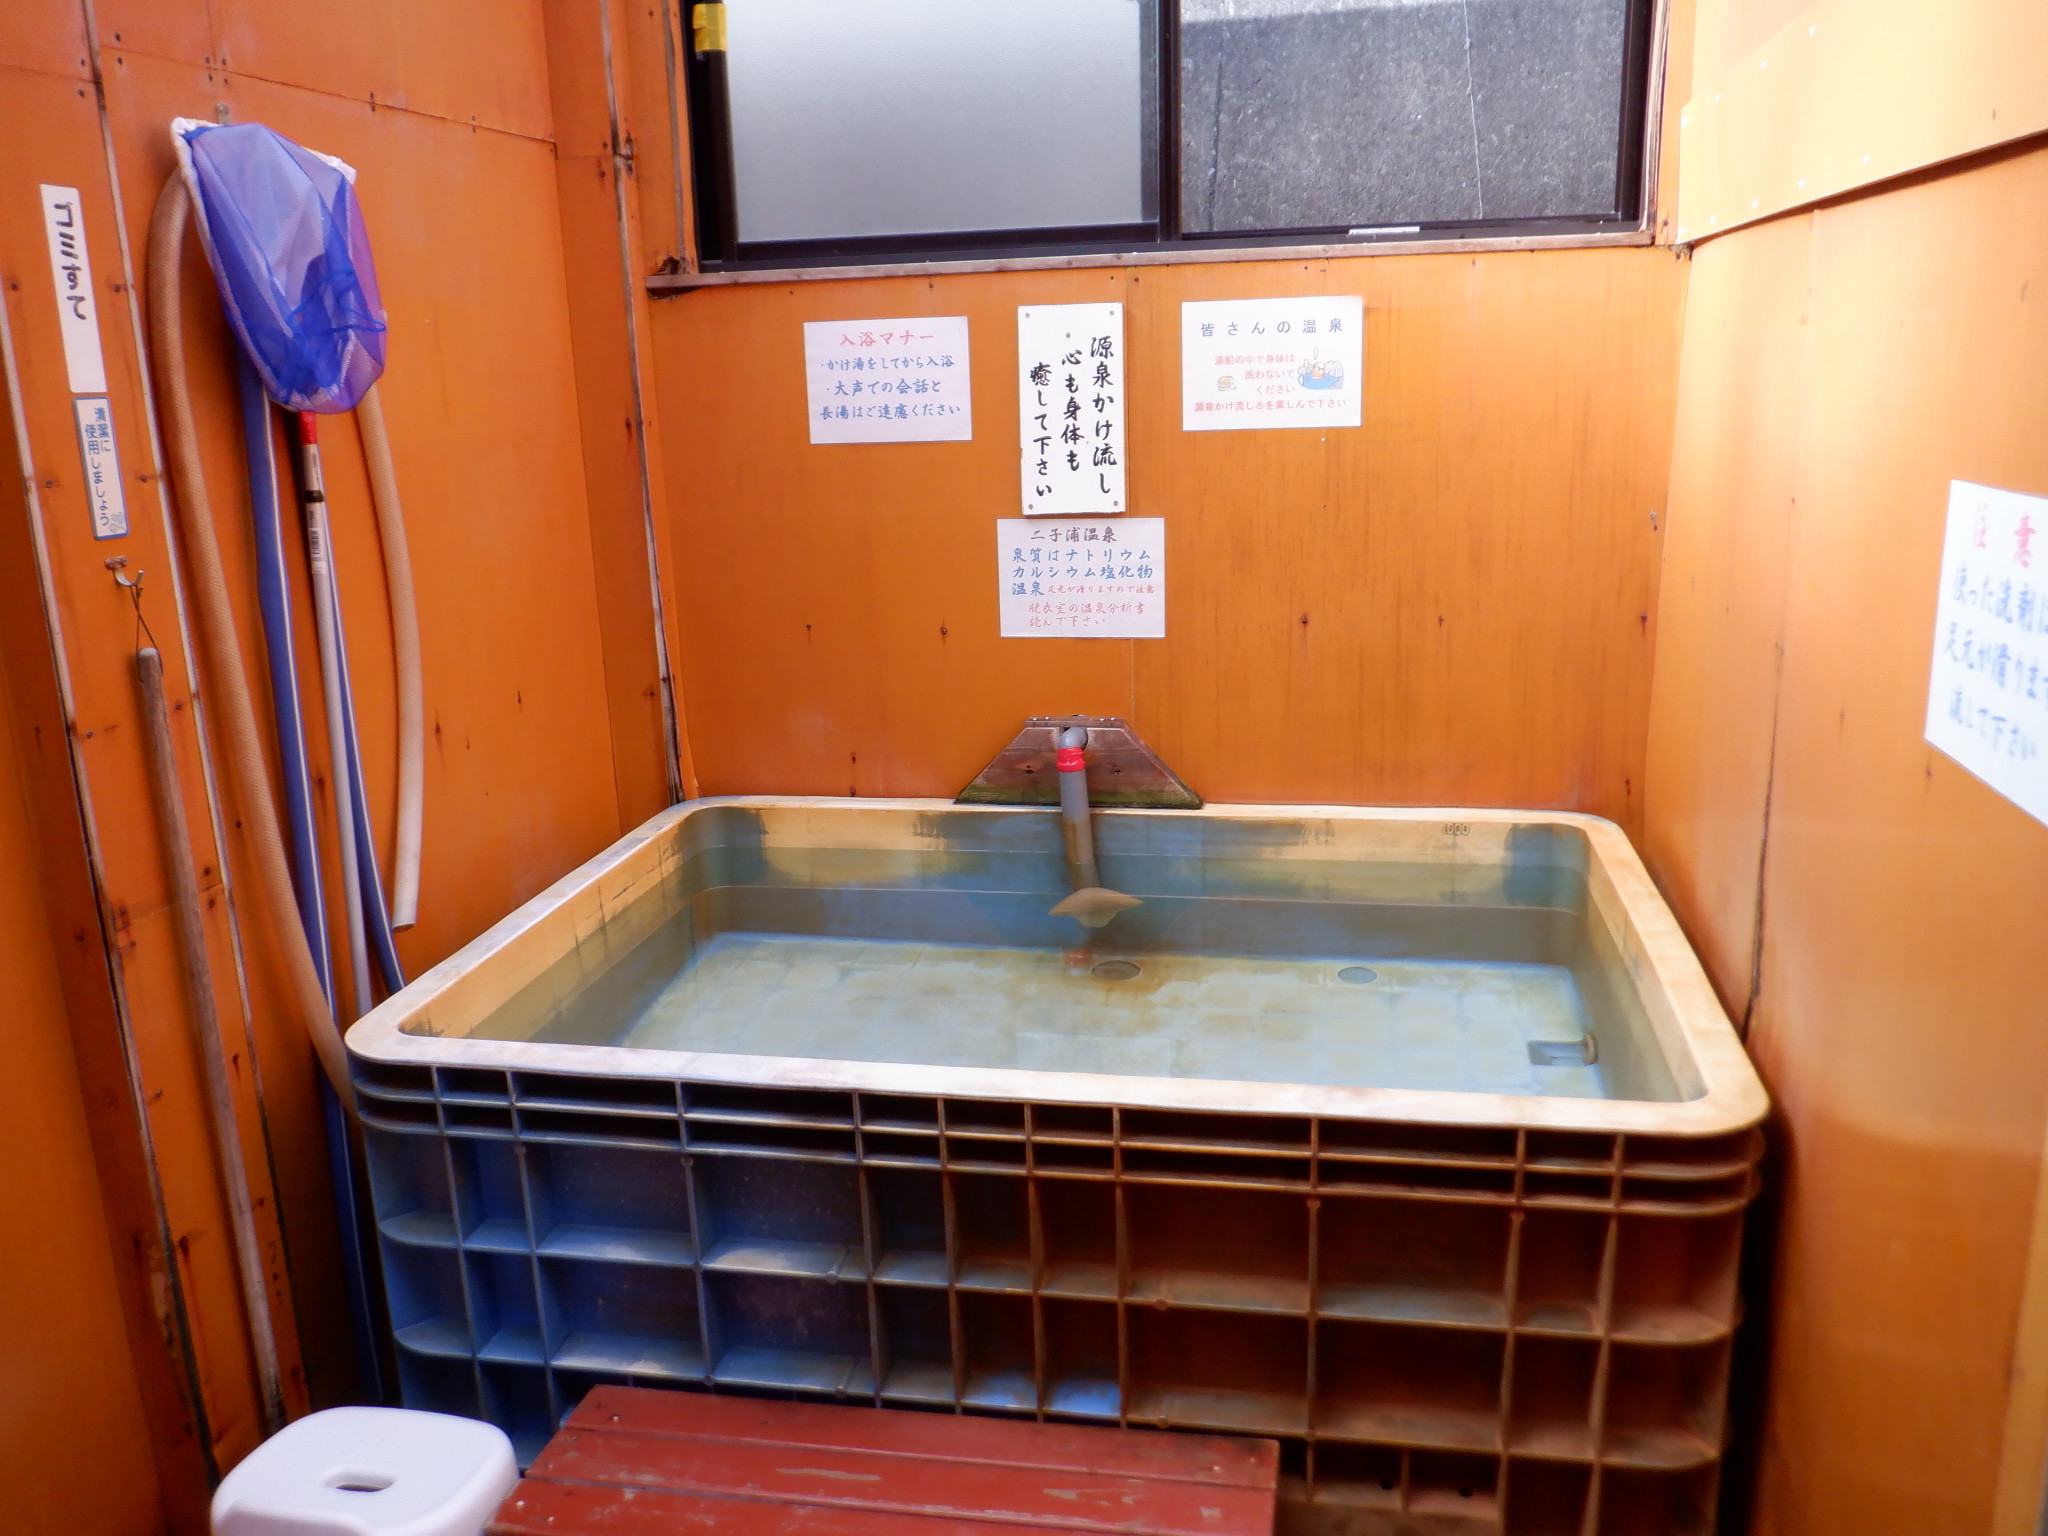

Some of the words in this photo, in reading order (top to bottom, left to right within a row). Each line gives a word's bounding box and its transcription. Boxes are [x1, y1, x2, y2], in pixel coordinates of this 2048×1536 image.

[53, 202, 87, 320] ゴミすて
[1200, 318, 1343, 337] 皆さんの温泉
[839, 330, 935, 347] 入浴マナー
[1214, 353, 1296, 366] 湯船の中で身体は
[1244, 369, 1296, 380] 洗わないで
[1255, 385, 1297, 395] ください
[819, 403, 961, 420] 長湯はご遠慮ください
[1060, 349, 1085, 472] 心も身体も
[1090, 335, 1117, 494] 源泉かけ流し
[93, 406, 112, 452] 清潔に
[1029, 361, 1052, 497] 癒して下さい
[84, 423, 110, 527] 使用しましょう
[1030, 526, 1118, 543] 二子浦温泉
[1011, 548, 1152, 564] 泉質はナトリウム
[1011, 565, 1154, 580] カルシウム塩化物
[1011, 581, 1046, 597] 温泉
[1047, 585, 1155, 595] 足元が滑りますので注意
[1028, 602, 1146, 616] 脱衣室の温泉分析書
[1028, 616, 1107, 628] 読んで下さい
